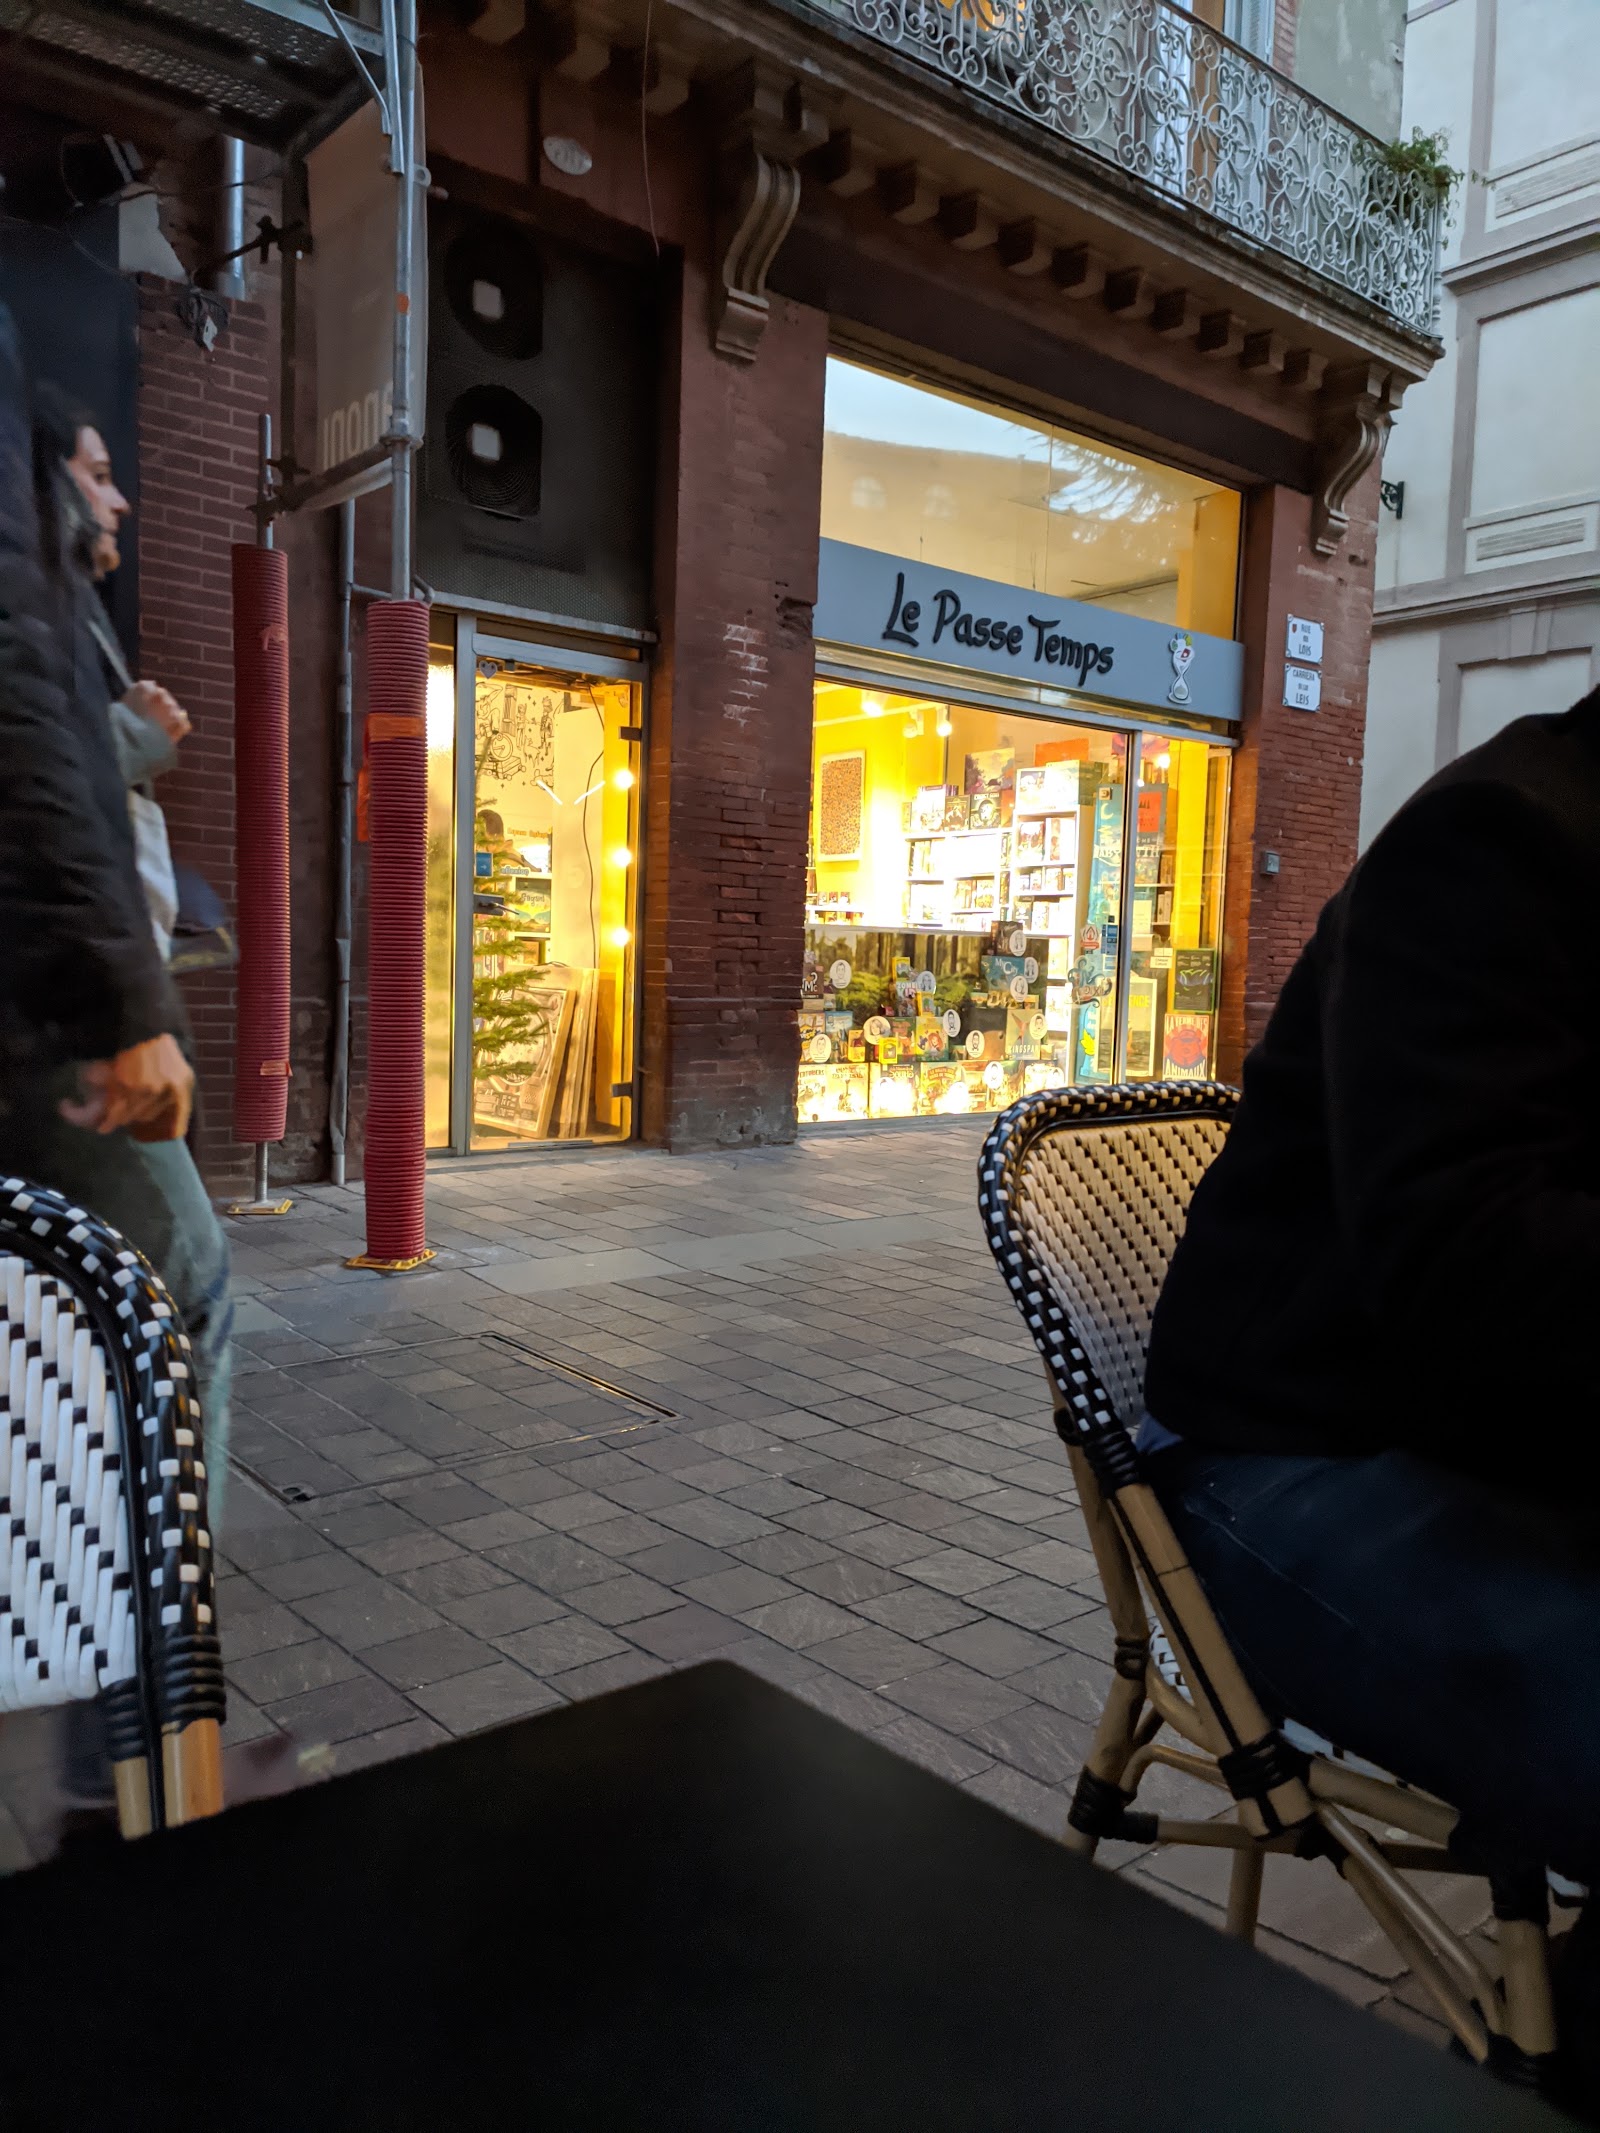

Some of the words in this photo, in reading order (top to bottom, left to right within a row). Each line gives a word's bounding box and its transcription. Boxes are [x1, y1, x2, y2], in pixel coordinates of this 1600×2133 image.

[881, 572, 921, 648] Le
[933, 589, 1024, 655] Passe
[1028, 614, 1115, 687] Temps
[1298, 643, 1312, 656] LOIS
[1295, 693, 1310, 706] LEIS
[1164, 1058, 1206, 1077] ANIMAUX
